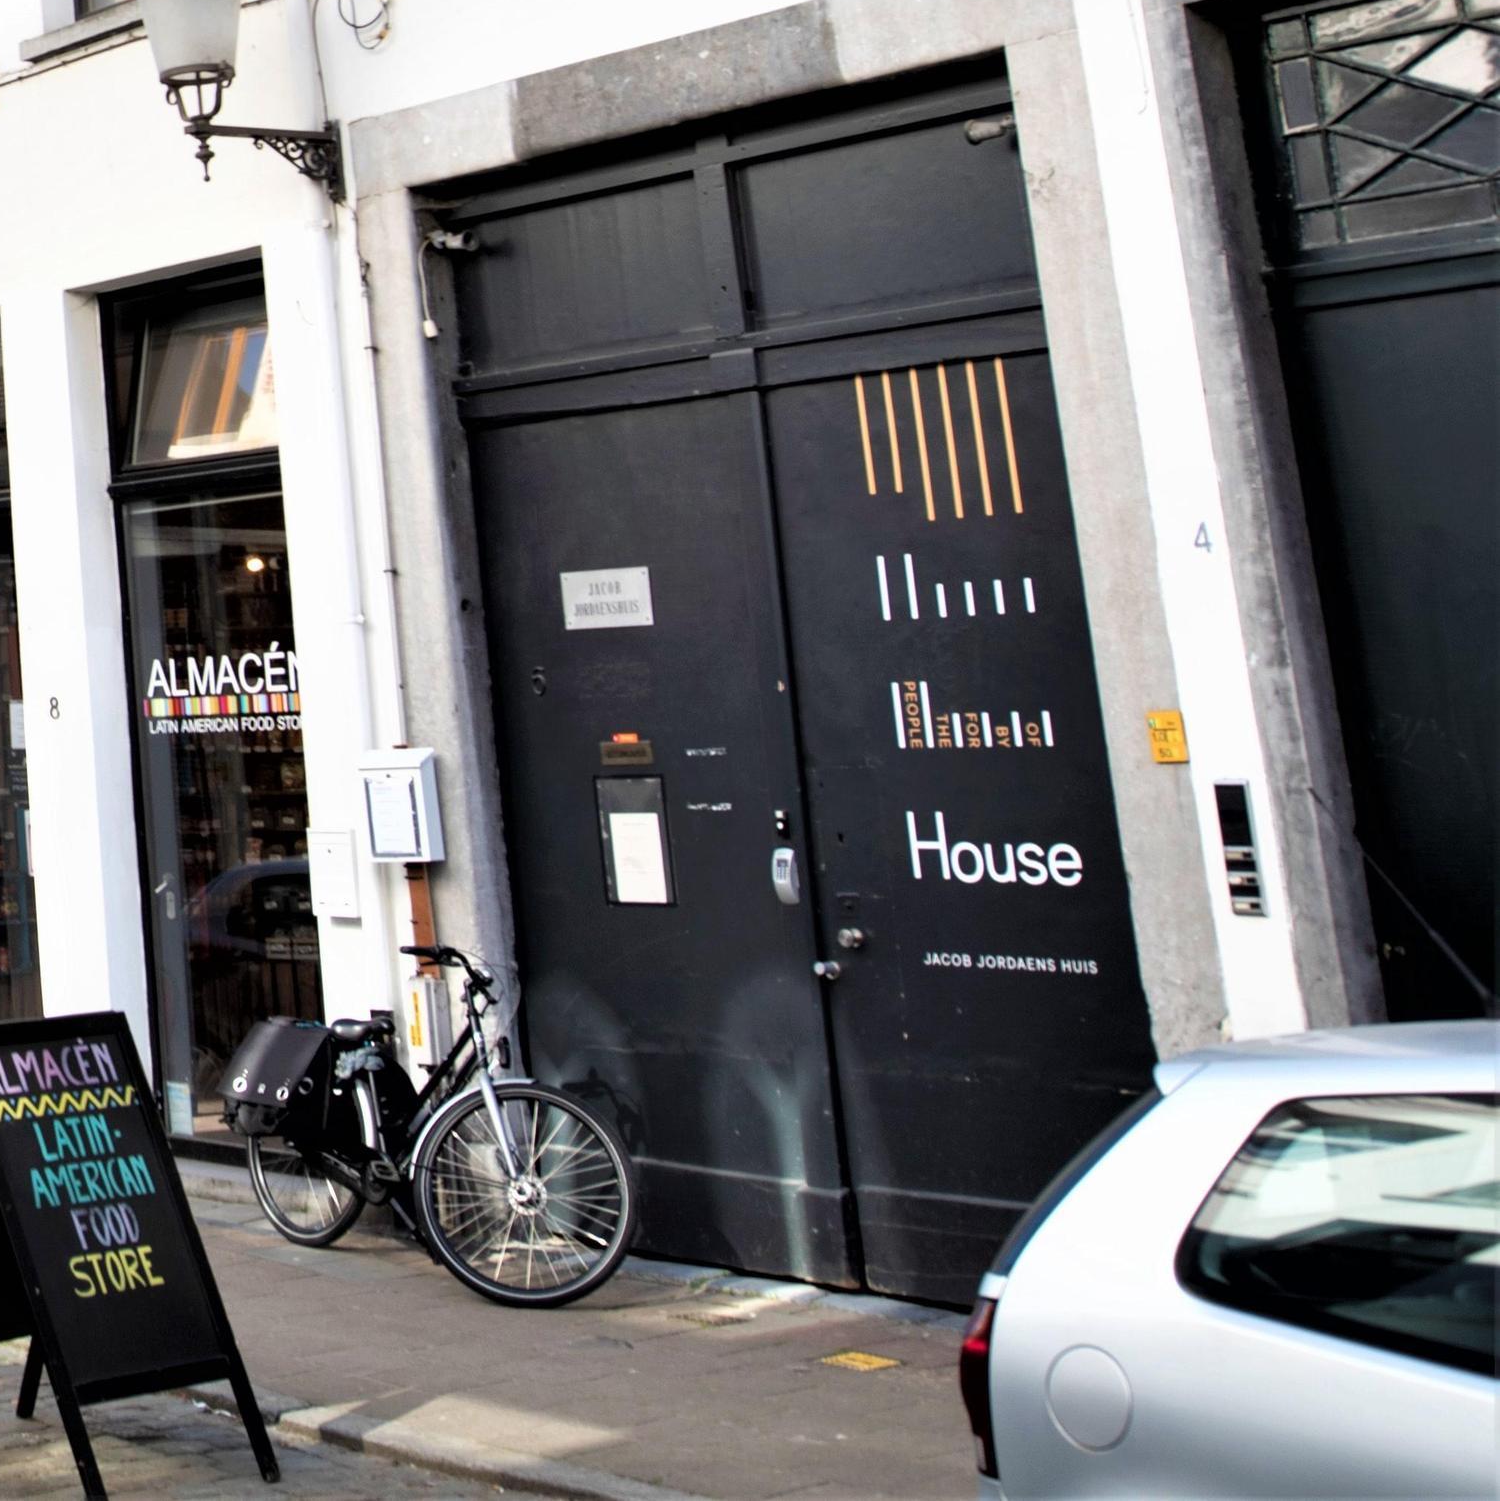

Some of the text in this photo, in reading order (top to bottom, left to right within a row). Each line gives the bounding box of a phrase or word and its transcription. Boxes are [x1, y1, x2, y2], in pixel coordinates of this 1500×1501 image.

[1194, 522, 1212, 553] 4
[588, 580, 622, 596] JACOB
[49, 696, 61, 720] 8
[148, 715, 302, 734] LATIN AMERICAN FOOD STO
[903, 680, 924, 749] PEOPLE
[936, 713, 952, 749] THE
[964, 712, 981, 749] FOR
[995, 725, 1011, 749] BY
[1025, 721, 1042, 747] OF
[906, 811, 1083, 887] House
[924, 952, 1099, 975] JACOB JORDAENS HUIS
[30, 1154, 156, 1209] AMERICAN
[70, 1202, 139, 1250] FOOD
[69, 1246, 165, 1298] STORE
